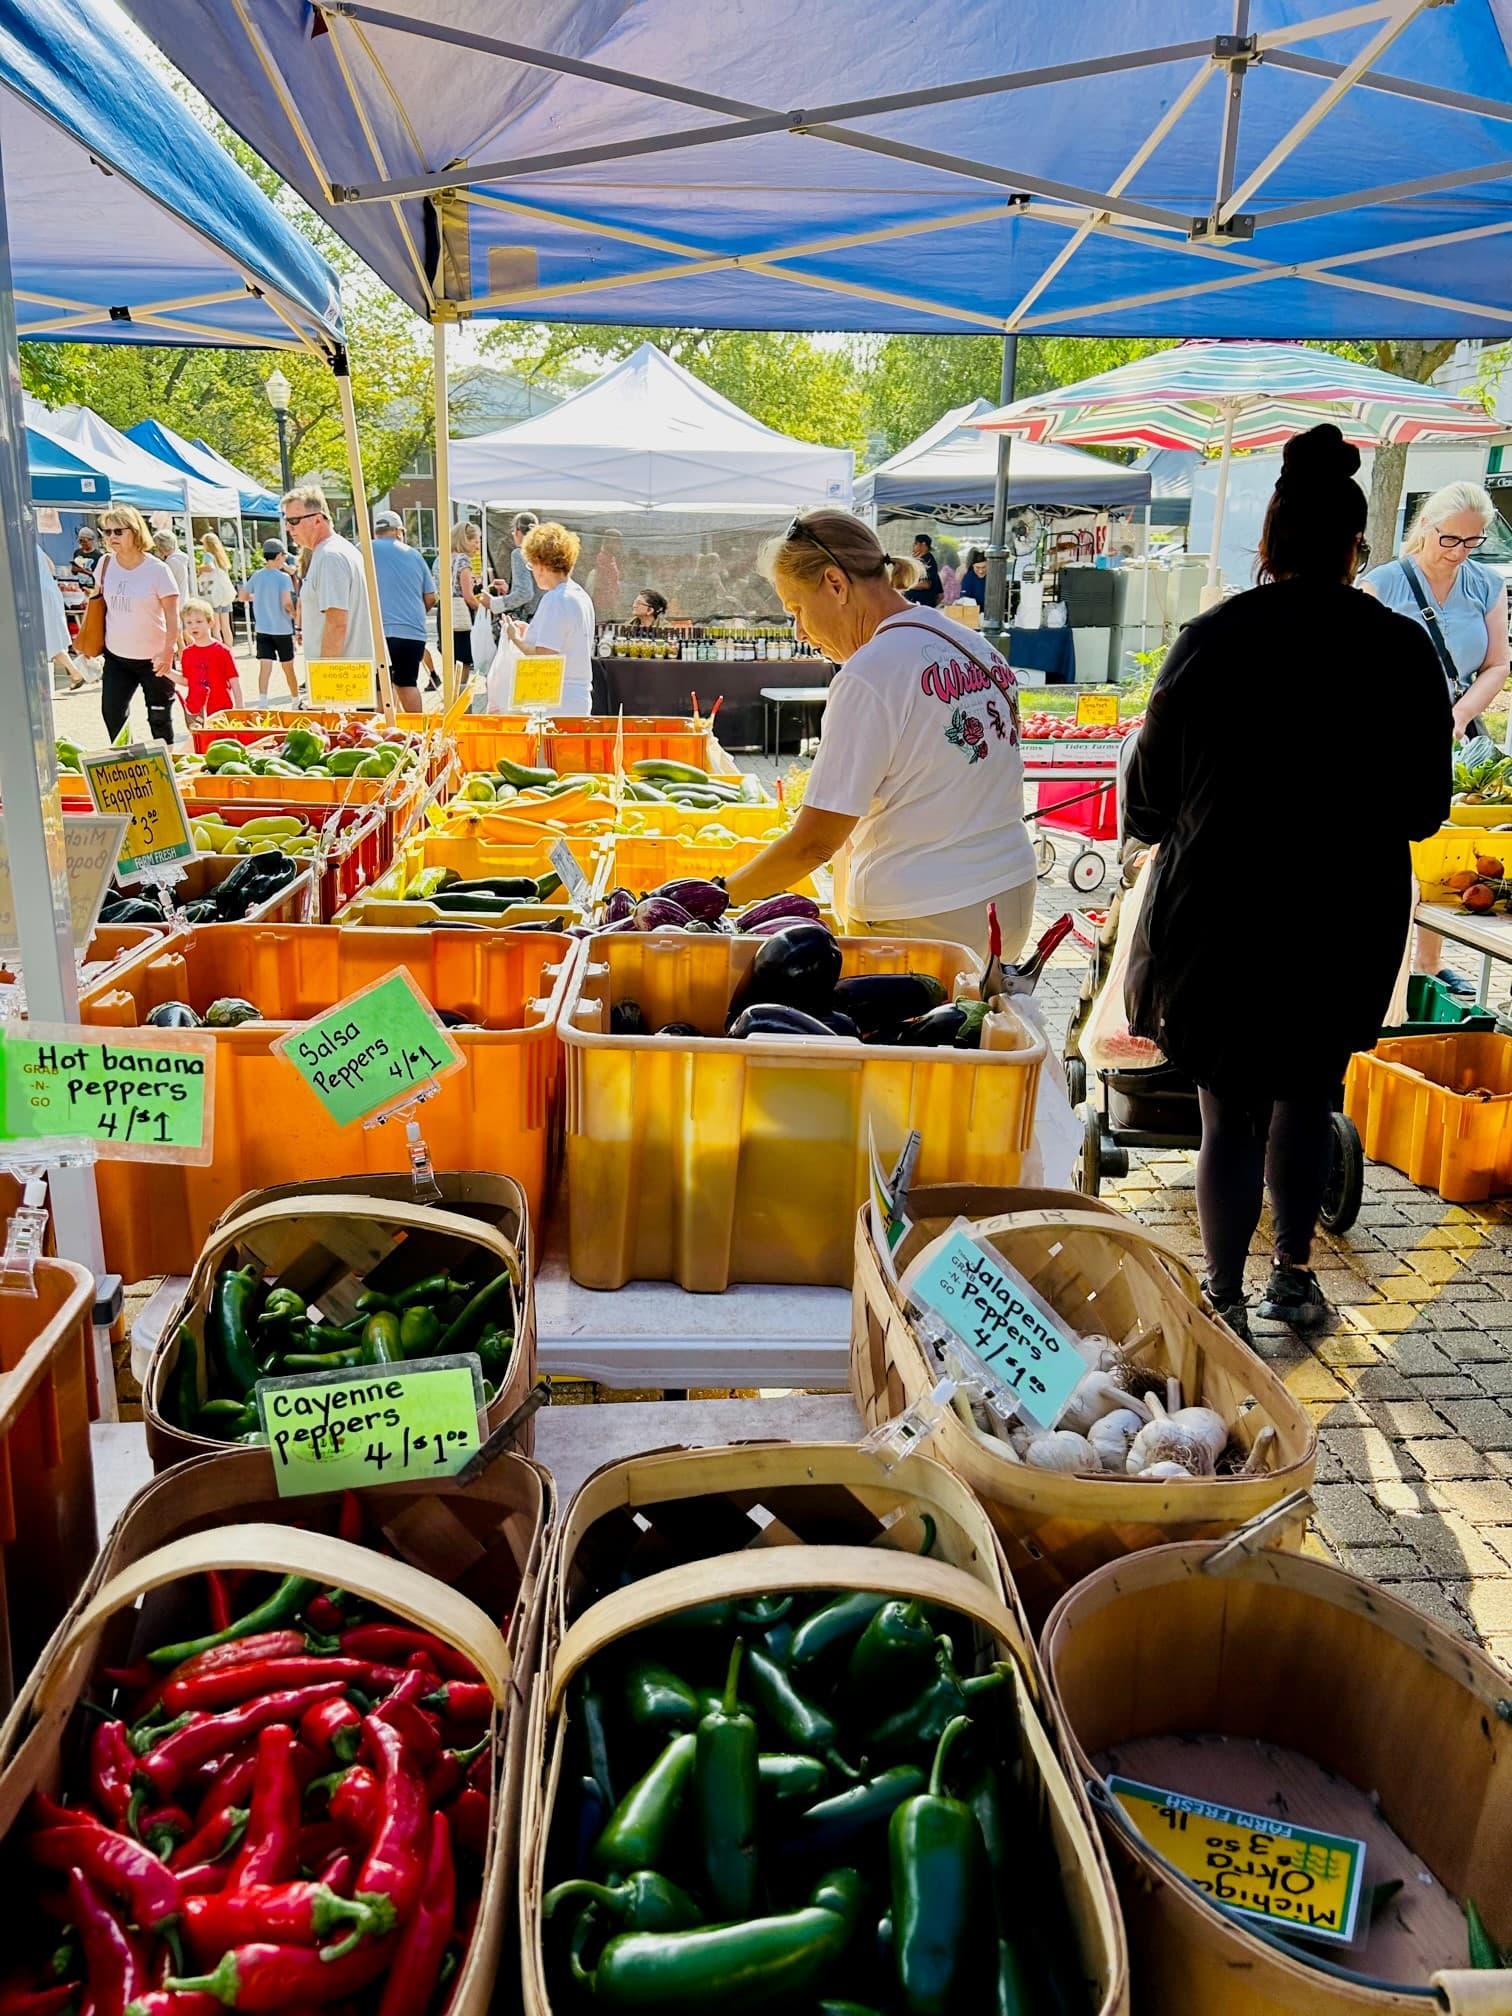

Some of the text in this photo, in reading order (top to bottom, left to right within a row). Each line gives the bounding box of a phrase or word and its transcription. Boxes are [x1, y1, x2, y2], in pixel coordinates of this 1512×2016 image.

[110, 595, 136, 613] MINE
[117, 580, 129, 595] BE
[921, 659, 991, 704] White
[96, 762, 150, 786] Michigan
[101, 778, 154, 813] Eggplant
[154, 847, 177, 864] FRESH
[38, 1044, 204, 1075] Hot banana
[298, 1022, 361, 1067] Salsa
[23, 1064, 60, 1076] GRAB
[313, 1038, 389, 1095] Peppers
[30, 1097, 51, 1107] GO
[68, 1079, 188, 1105] peppers
[950, 1255, 977, 1283] GRAB
[939, 1279, 955, 1296] GO
[961, 1282, 1043, 1361] Peppers
[965, 1256, 1061, 1354] Jalapeno
[273, 1380, 405, 1426] Cayenne
[274, 1407, 401, 1465] peppers
[1151, 1803, 1188, 1832] lb.
[1164, 1794, 1293, 1840] FARM FRESH
[1206, 1853, 1316, 1896] Okra
[1191, 1871, 1336, 1926] Michiga
